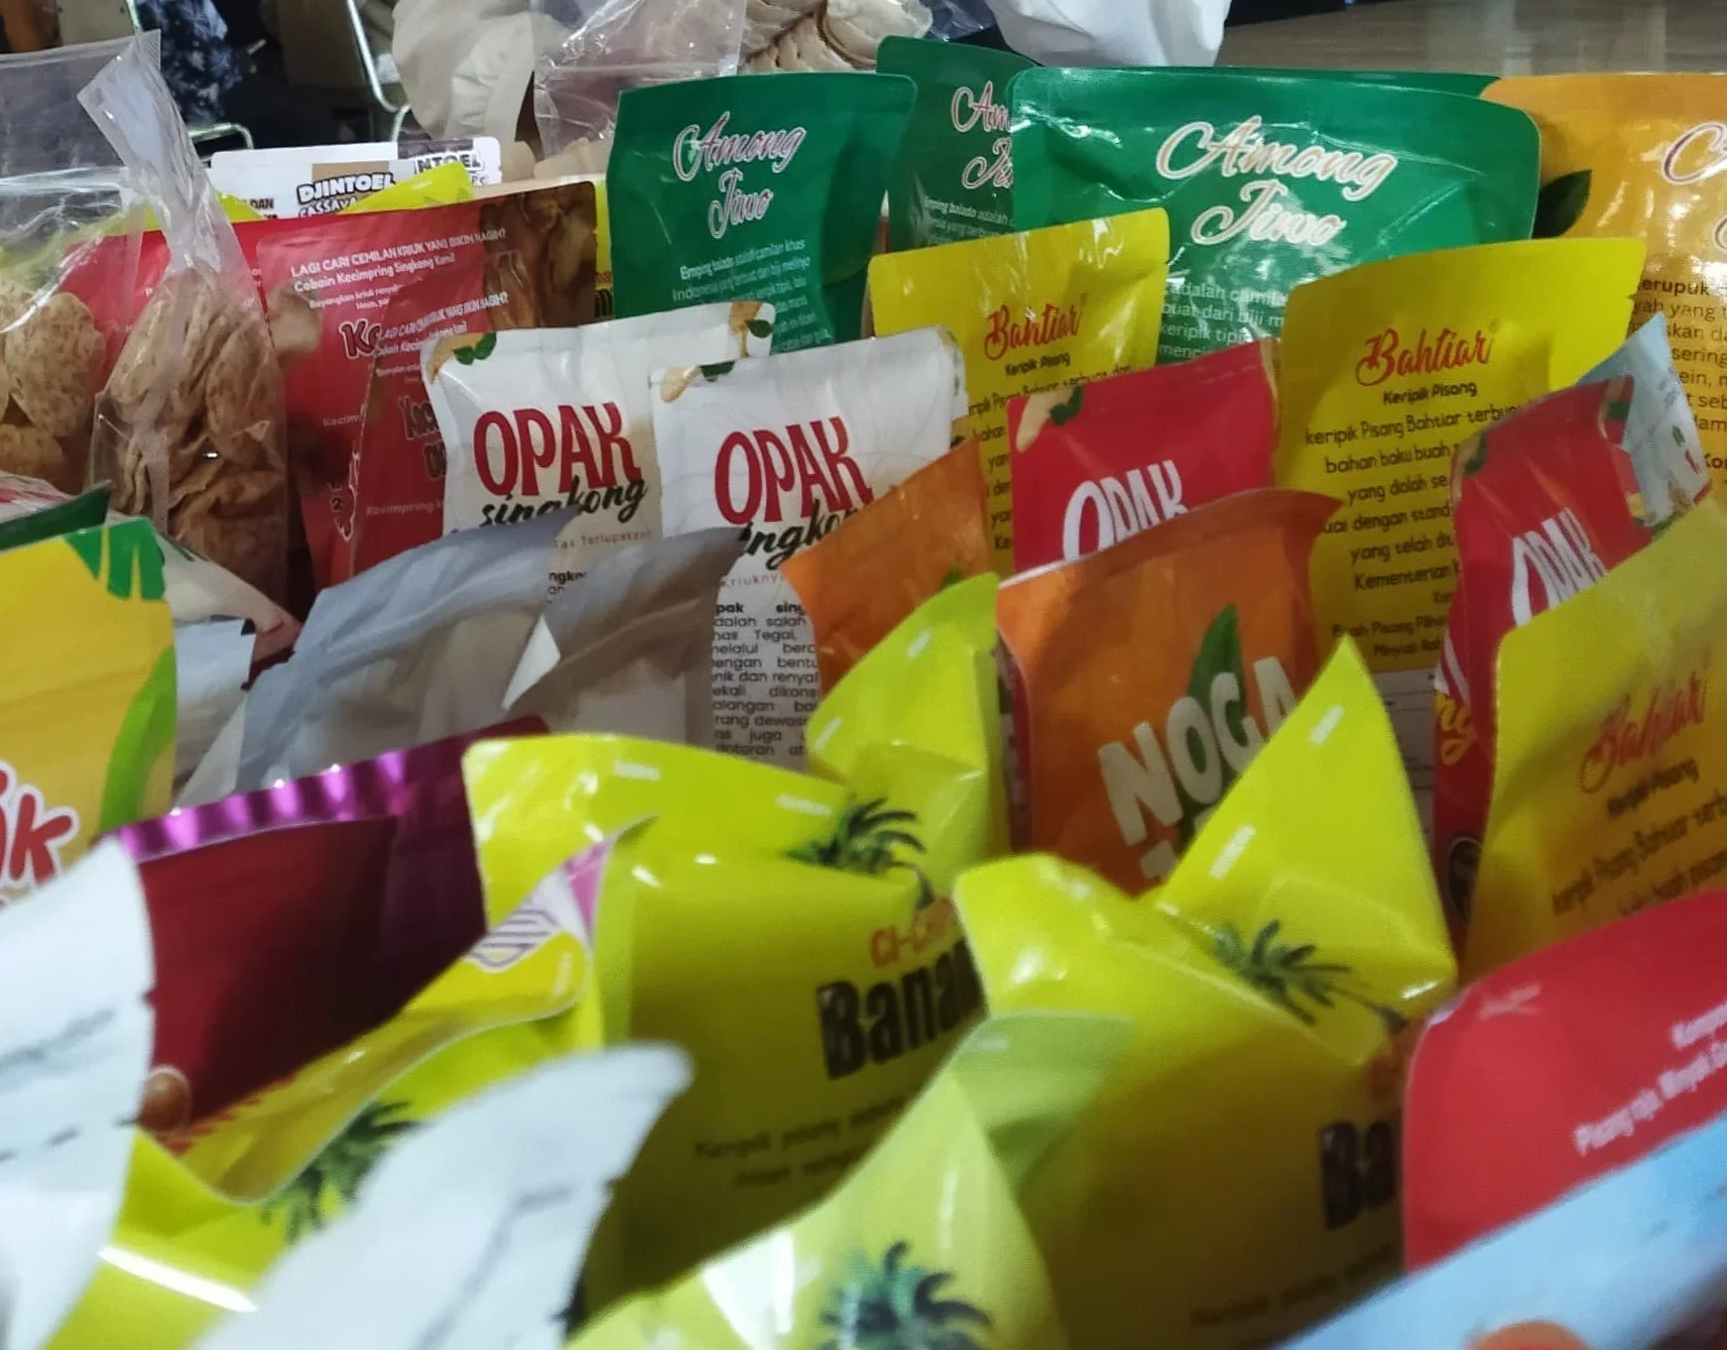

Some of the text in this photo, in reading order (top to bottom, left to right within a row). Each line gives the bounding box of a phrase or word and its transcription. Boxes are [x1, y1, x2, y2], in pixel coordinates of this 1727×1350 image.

[673, 111, 807, 181] Among
[1156, 114, 1398, 201] Among
[414, 151, 481, 175] NTOEL
[296, 172, 396, 204] DJINTOEL
[1191, 179, 1347, 246] Jiwo
[291, 261, 320, 278] LAGI
[322, 255, 350, 271] CARI
[351, 247, 396, 266] CEMILAN
[425, 238, 449, 252] YANG
[294, 276, 336, 293] Cobain
[394, 258, 435, 276] Singkong
[1170, 282, 1225, 300] adalah
[1203, 305, 1234, 321] dari
[1669, 303, 1716, 323] yang
[1356, 327, 1496, 387] Bahtiar
[1383, 379, 1478, 406] Keripik Pisang
[1680, 372, 1712, 388] ein,
[1305, 427, 1359, 448] keripik
[1361, 419, 1405, 441] Pisang
[1407, 411, 1462, 433] Bahtiar
[473, 402, 642, 496] OPAK
[988, 453, 1009, 473] yan
[1325, 441, 1452, 475] bahan baku buah
[714, 416, 874, 525] OPAK
[1347, 482, 1387, 506] yang
[1389, 475, 1428, 495] diolah
[739, 498, 858, 570] ngko
[1353, 508, 1409, 534] dengan
[1350, 543, 1392, 569] yang
[1394, 535, 1434, 556] telah
[1353, 564, 1453, 592] Kementerian
[715, 616, 807, 628] dalah salah
[717, 602, 744, 616] pak
[712, 685, 747, 697] ekali
[738, 672, 768, 683] dan
[712, 700, 775, 715] alangan
[714, 715, 750, 729] rang
[749, 729, 783, 744] juga
[1096, 655, 1299, 847] NOGA
